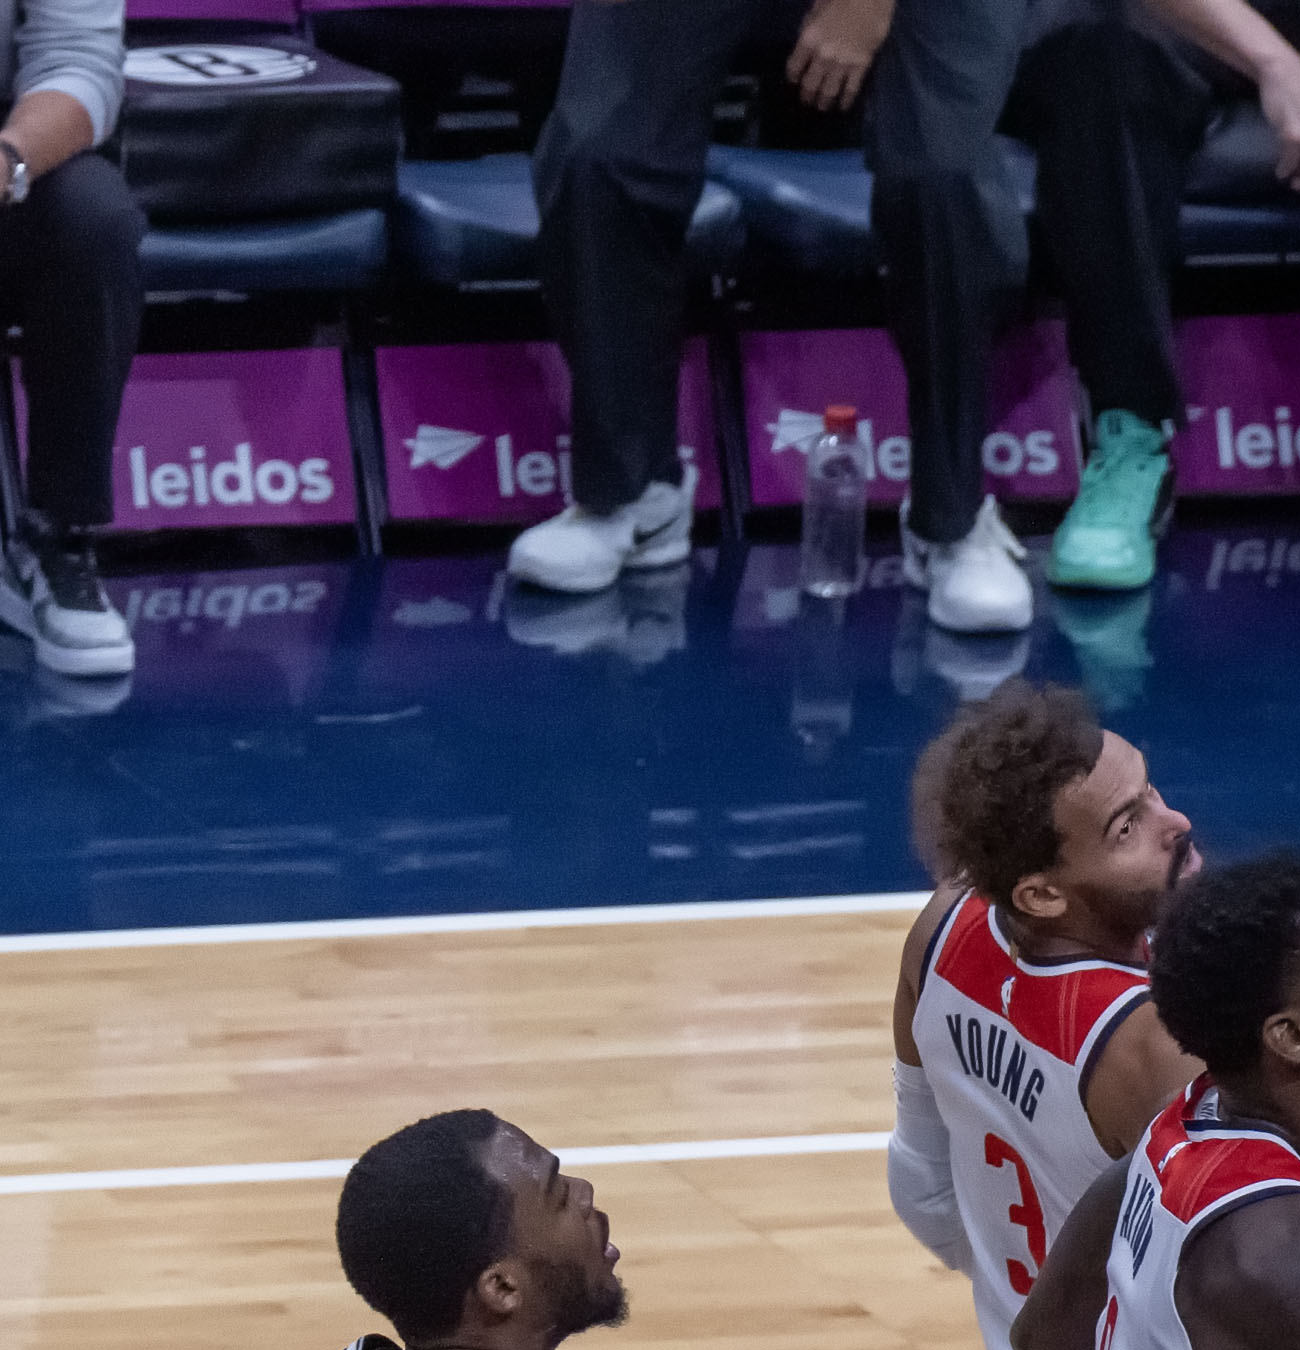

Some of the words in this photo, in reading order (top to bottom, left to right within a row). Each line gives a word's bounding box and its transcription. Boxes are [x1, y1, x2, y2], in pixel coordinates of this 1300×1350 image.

[129, 441, 334, 510] leidos
[856, 418, 1059, 482] leos
[946, 1013, 1045, 1123] YOUNG
[984, 1132, 1046, 1297] 3
